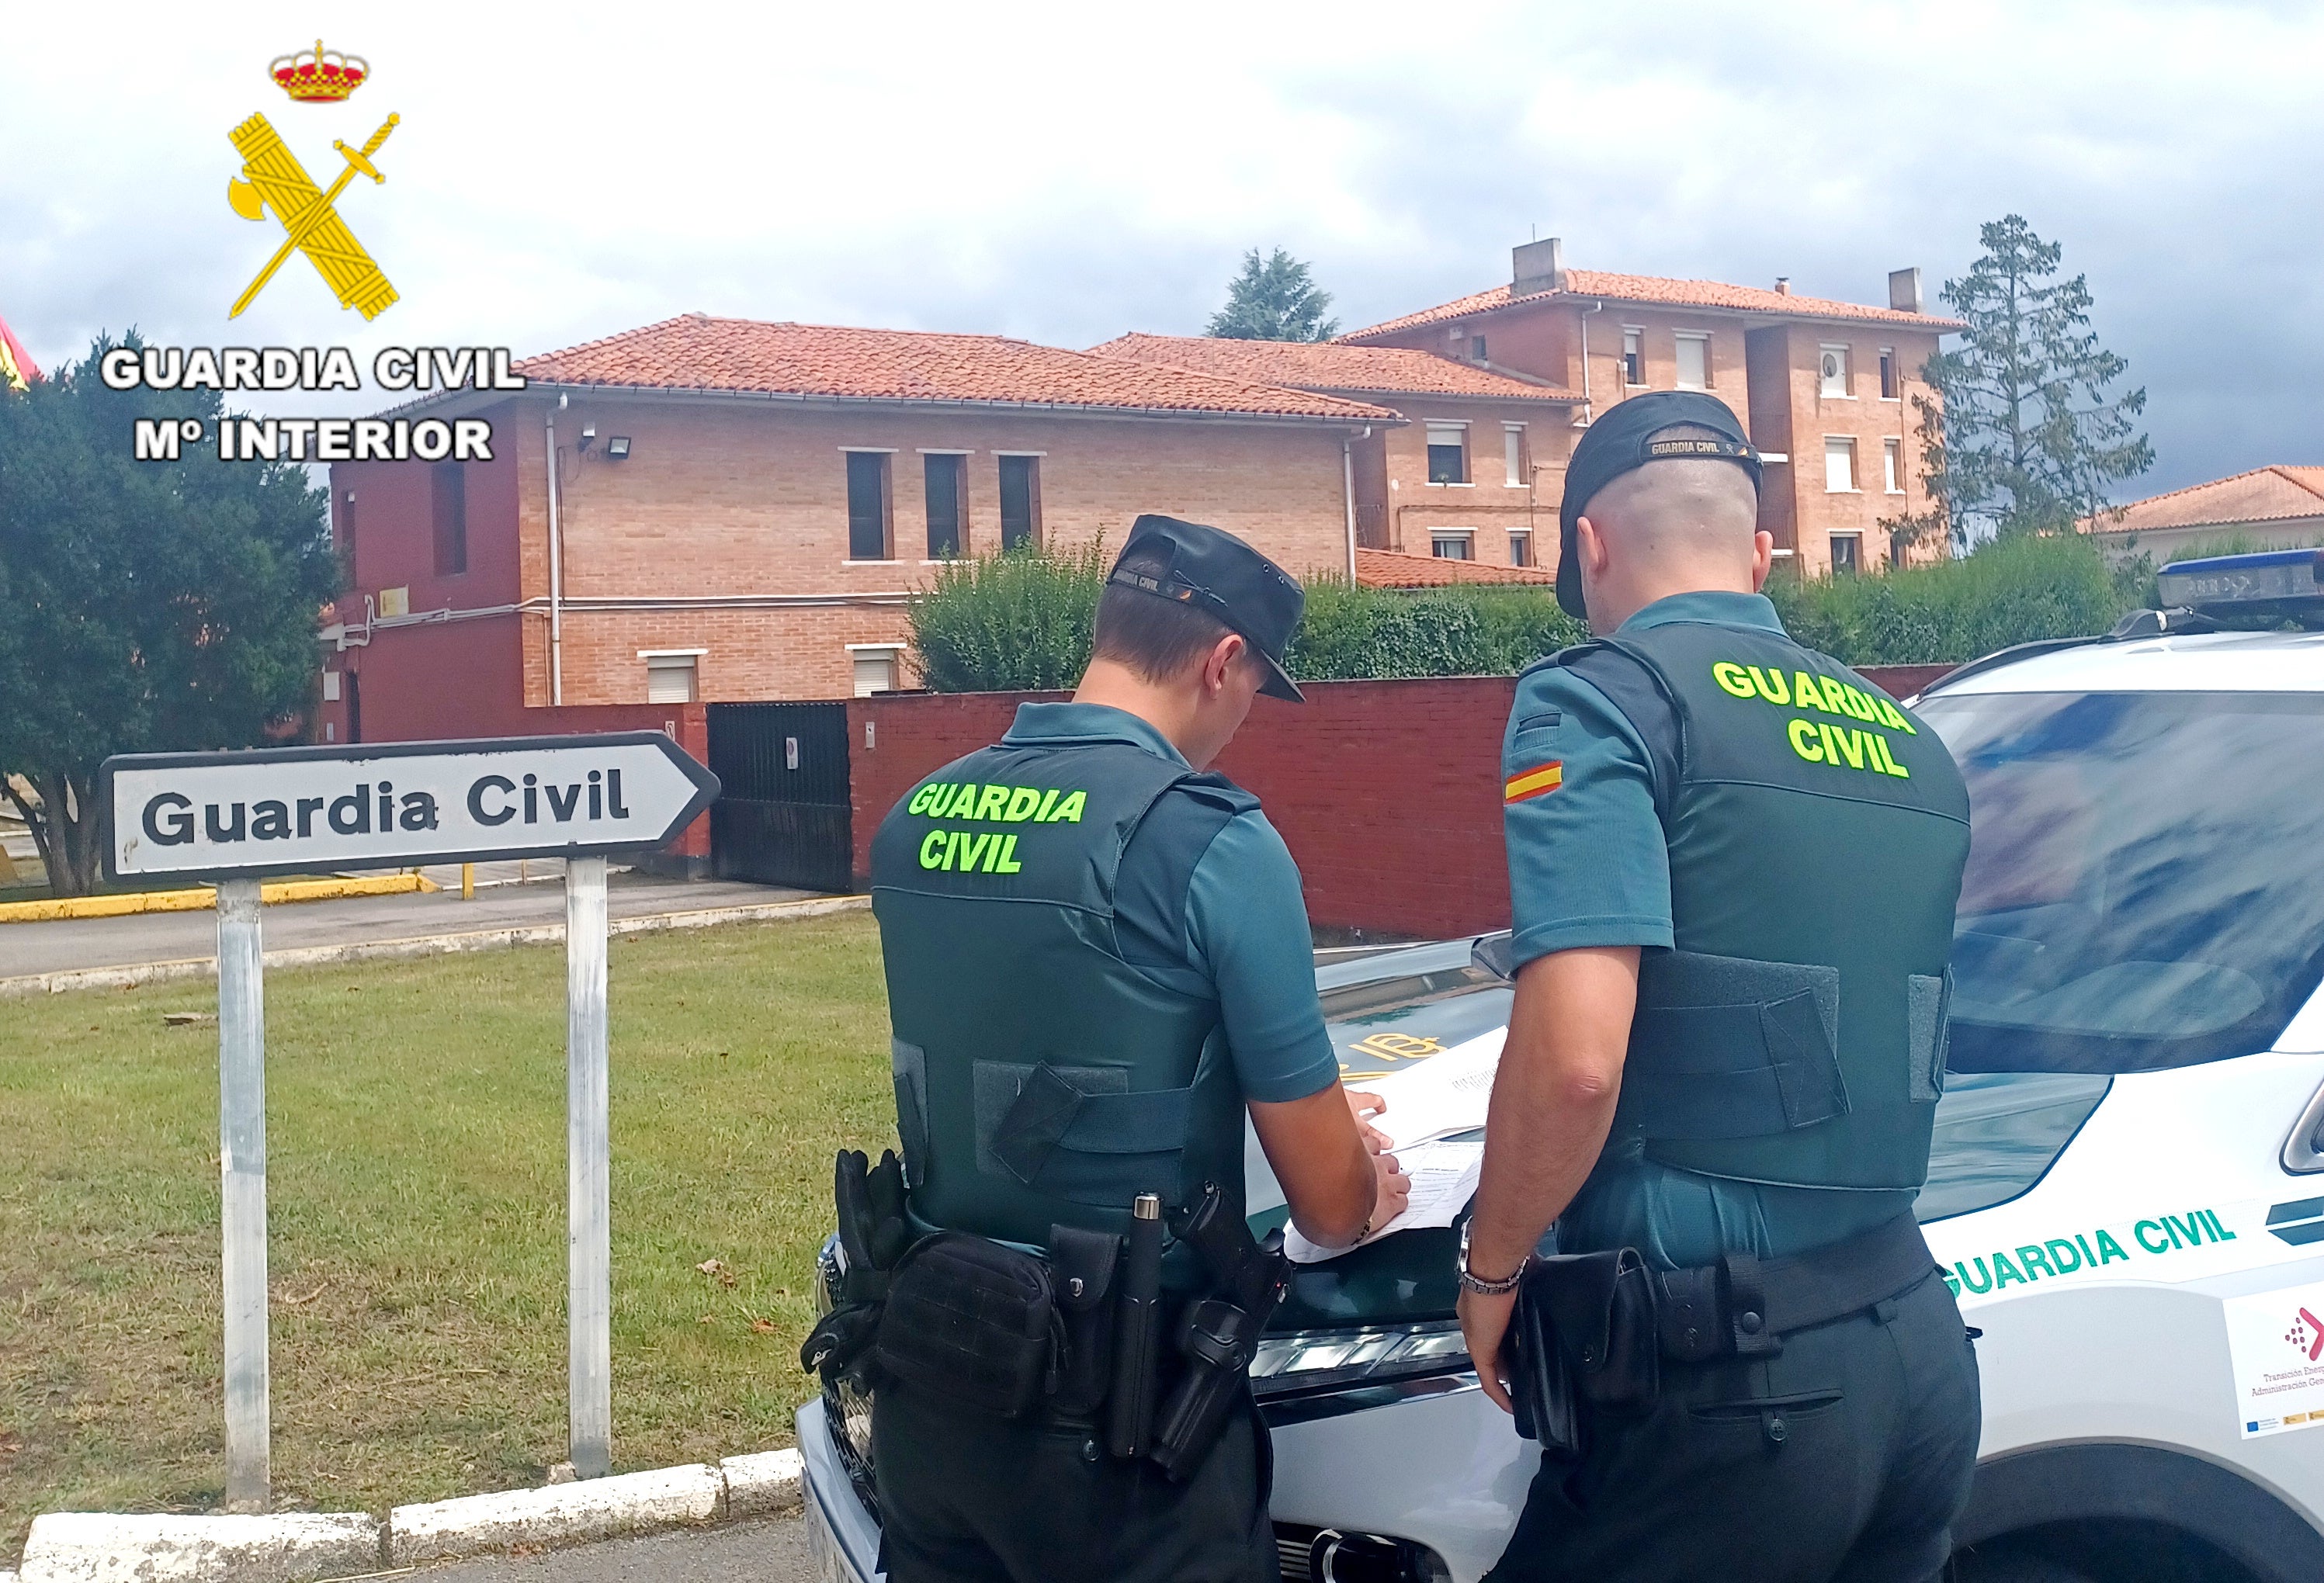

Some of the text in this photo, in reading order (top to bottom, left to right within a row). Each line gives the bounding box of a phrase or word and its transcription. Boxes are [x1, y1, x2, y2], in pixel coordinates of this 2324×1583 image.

[1651, 442, 1720, 455] GUARDIA CIVIL
[1712, 661, 1917, 736] GUARDIA
[1787, 718, 1910, 779] CIVIL
[142, 769, 629, 846] Guardia Civil
[907, 782, 1087, 823] GUARDIA
[918, 829, 1022, 874] CIVIL
[2134, 1209, 2237, 1254] CIVIL
[2252, 1380, 2308, 1397] Administración
[2263, 1369, 2303, 1382] Transición
